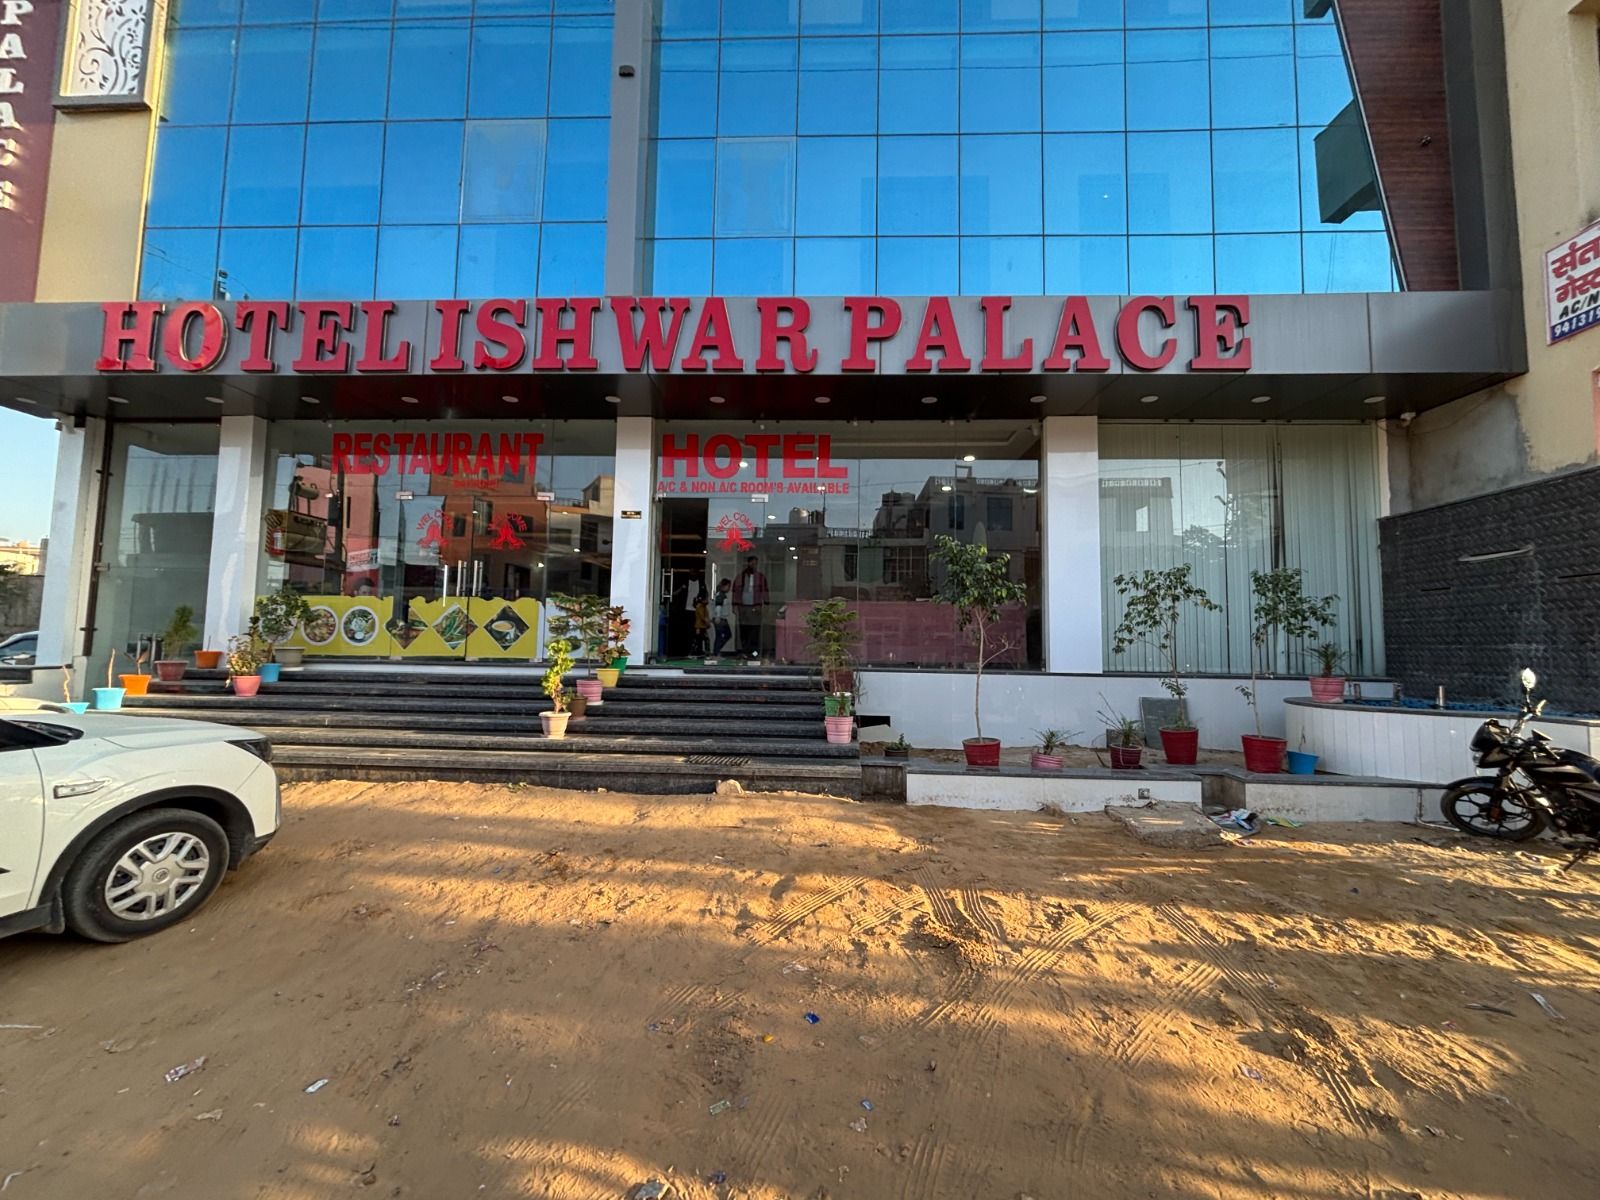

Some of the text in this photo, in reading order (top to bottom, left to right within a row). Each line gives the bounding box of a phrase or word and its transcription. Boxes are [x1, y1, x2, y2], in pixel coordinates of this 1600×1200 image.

[96, 295, 1251, 373] HOTEL ISHWAR PALACE
[332, 432, 545, 477] RESTAURANT
[662, 433, 848, 479] HOTEL
[657, 481, 676, 492] A/C
[680, 481, 687, 492] &
[691, 481, 715, 493] NON
[719, 481, 737, 493] A/C
